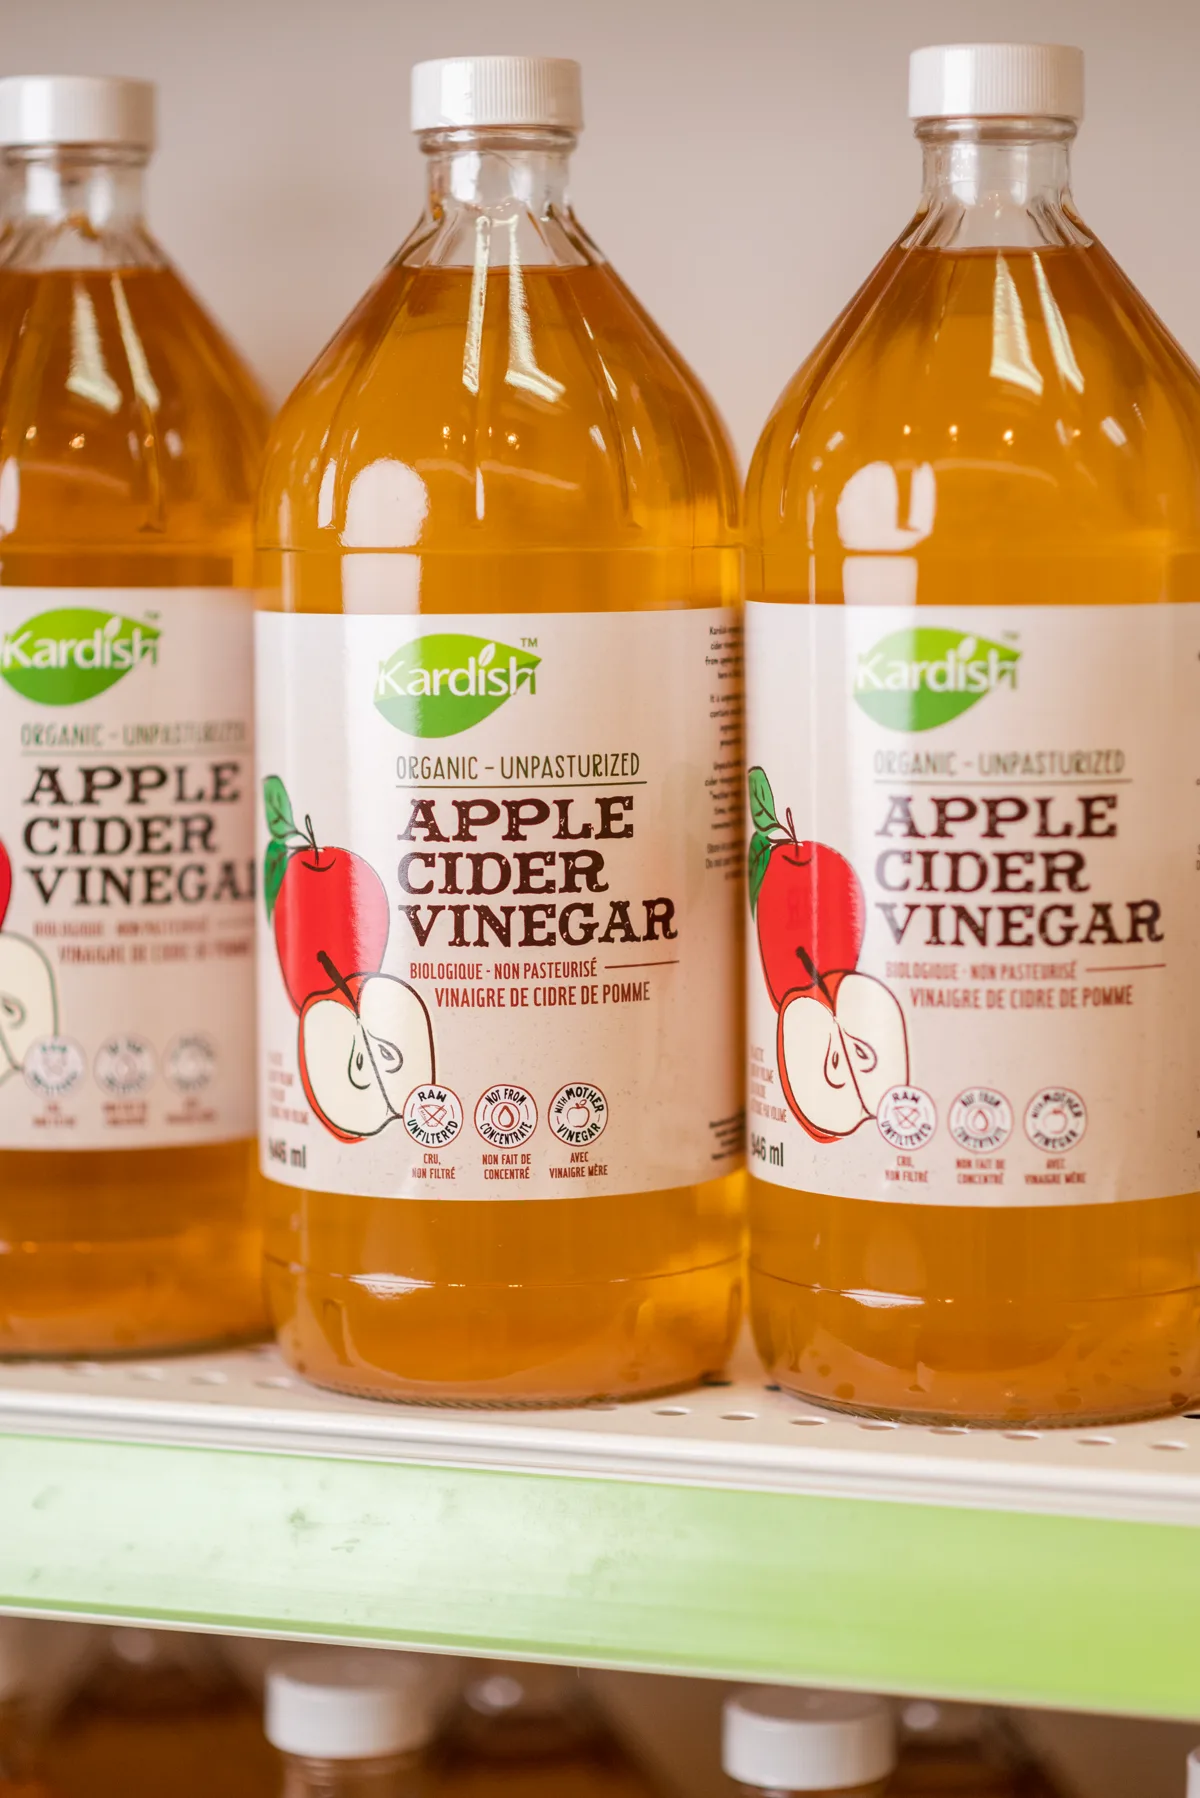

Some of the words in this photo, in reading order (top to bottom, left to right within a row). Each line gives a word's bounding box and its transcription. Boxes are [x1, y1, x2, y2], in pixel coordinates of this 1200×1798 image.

[3, 616, 159, 669] Kardish
[520, 638, 538, 647] TM
[378, 643, 536, 697] Kardish
[857, 637, 1018, 692] Kardish
[21, 723, 105, 746] ORGANIC
[396, 756, 478, 780] ORGANIC
[500, 752, 640, 780] UNPASTURIZED
[874, 749, 957, 776] ORGANIC
[978, 749, 1126, 776] UNPASTURIZED
[22, 762, 241, 806] APPLE
[397, 795, 634, 842] APPLE
[874, 794, 1118, 839] APPLE
[23, 812, 218, 857] CIDER
[22, 857, 255, 906] VINEGA
[397, 849, 610, 896] CIDER
[874, 849, 1091, 893] CIDER
[398, 897, 679, 948] VINEGAR
[874, 899, 1165, 947] VINEGAR
[409, 962, 483, 980] BIOLOGIQUE
[494, 963, 520, 980] NON
[523, 957, 598, 979] PASTEURISÉ
[435, 987, 506, 1008] VINAIGRE
[510, 987, 529, 1008] DE
[533, 985, 577, 1007] CIDRE
[581, 984, 599, 1005] DE
[602, 981, 651, 1004] POMME
[910, 986, 980, 1008] VINAIGRE
[985, 987, 1004, 1009] DE
[1010, 987, 1055, 1009] CIDRE
[1060, 986, 1078, 1008] DE
[1083, 984, 1133, 1007] POMME
[417, 1089, 447, 1103] RAW
[485, 1089, 501, 1106] NOT
[504, 1088, 528, 1106] FROM
[554, 1096, 569, 1114] WITH
[565, 1086, 605, 1114] MOTHER
[407, 1118, 459, 1145] UNFILTERED
[480, 1121, 533, 1145] CONCENTRATE
[556, 1121, 601, 1143] VINEGAR
[482, 1154, 499, 1165] NON
[502, 1154, 518, 1165] FAIT
[521, 1153, 532, 1165] DE
[570, 1152, 589, 1163] AVEC
[769, 1142, 784, 1167] ml
[411, 1168, 427, 1179] NON
[429, 1166, 456, 1179] FILTRÉ
[483, 1167, 530, 1180] CONCENTRÉ
[549, 1167, 585, 1179] VINAIGRE
[588, 1164, 609, 1177] MÈRE
